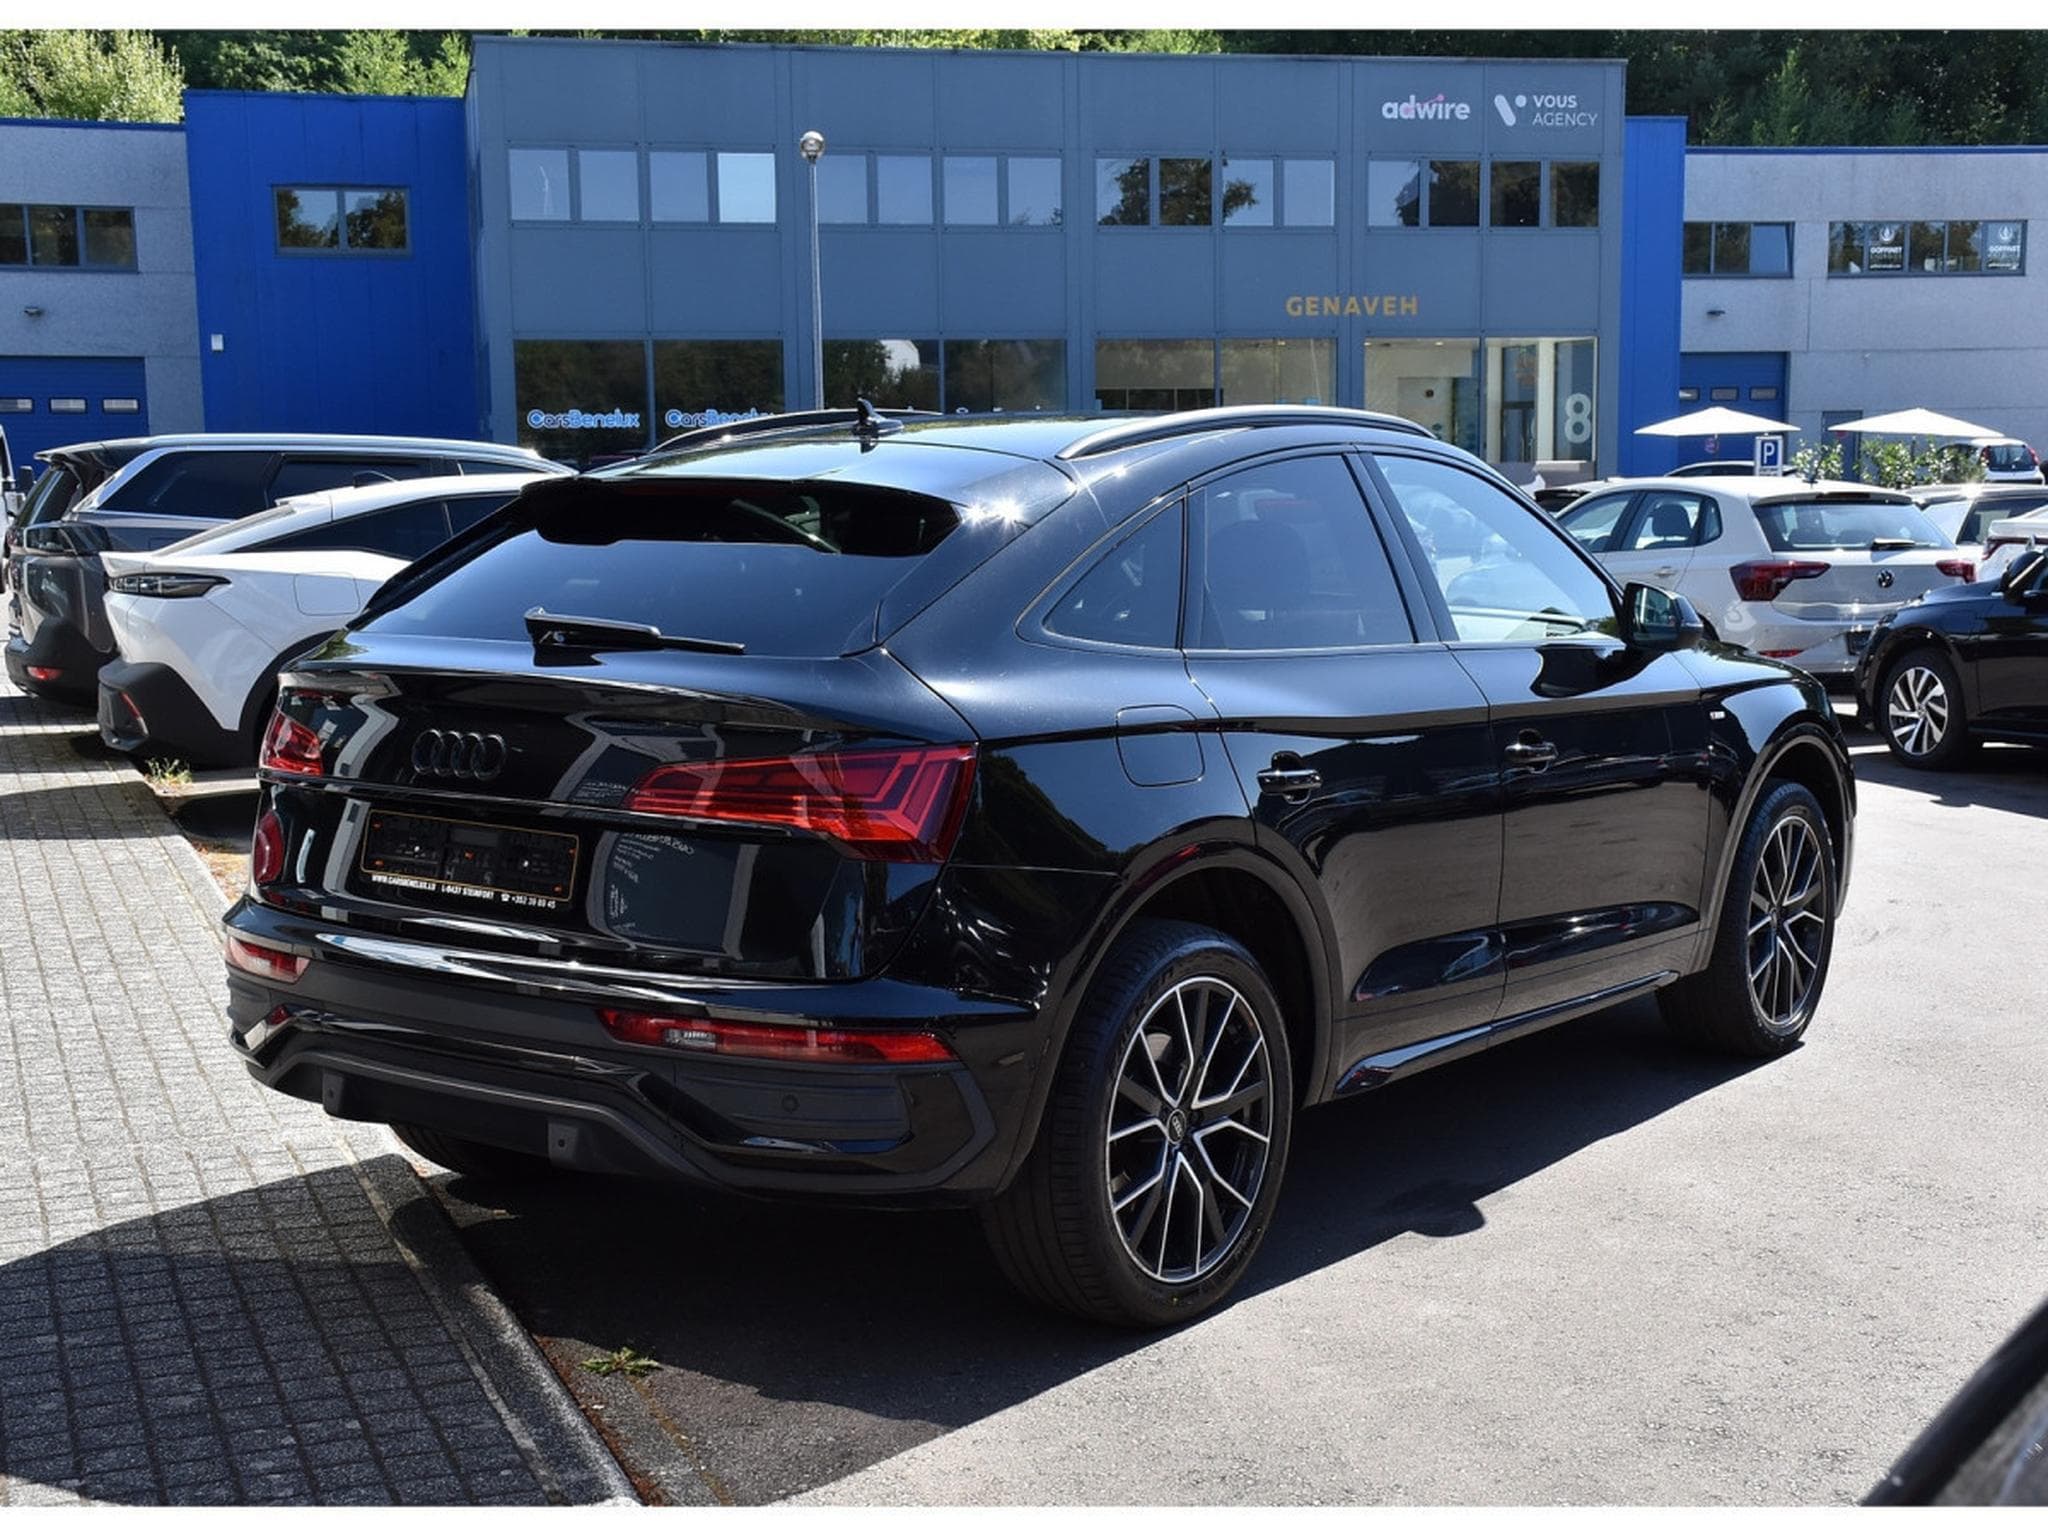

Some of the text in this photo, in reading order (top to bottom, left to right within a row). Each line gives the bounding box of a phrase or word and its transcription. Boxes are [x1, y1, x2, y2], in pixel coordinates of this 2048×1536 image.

[1382, 94, 1471, 120] adwire
[1532, 95, 1578, 108] VOUS
[1532, 112, 1598, 127] AGENCY
[1286, 296, 1418, 316] GENAVEH
[527, 408, 641, 430] CarsBenelux
[1564, 392, 1593, 444] 8
[1763, 442, 1775, 465] P
